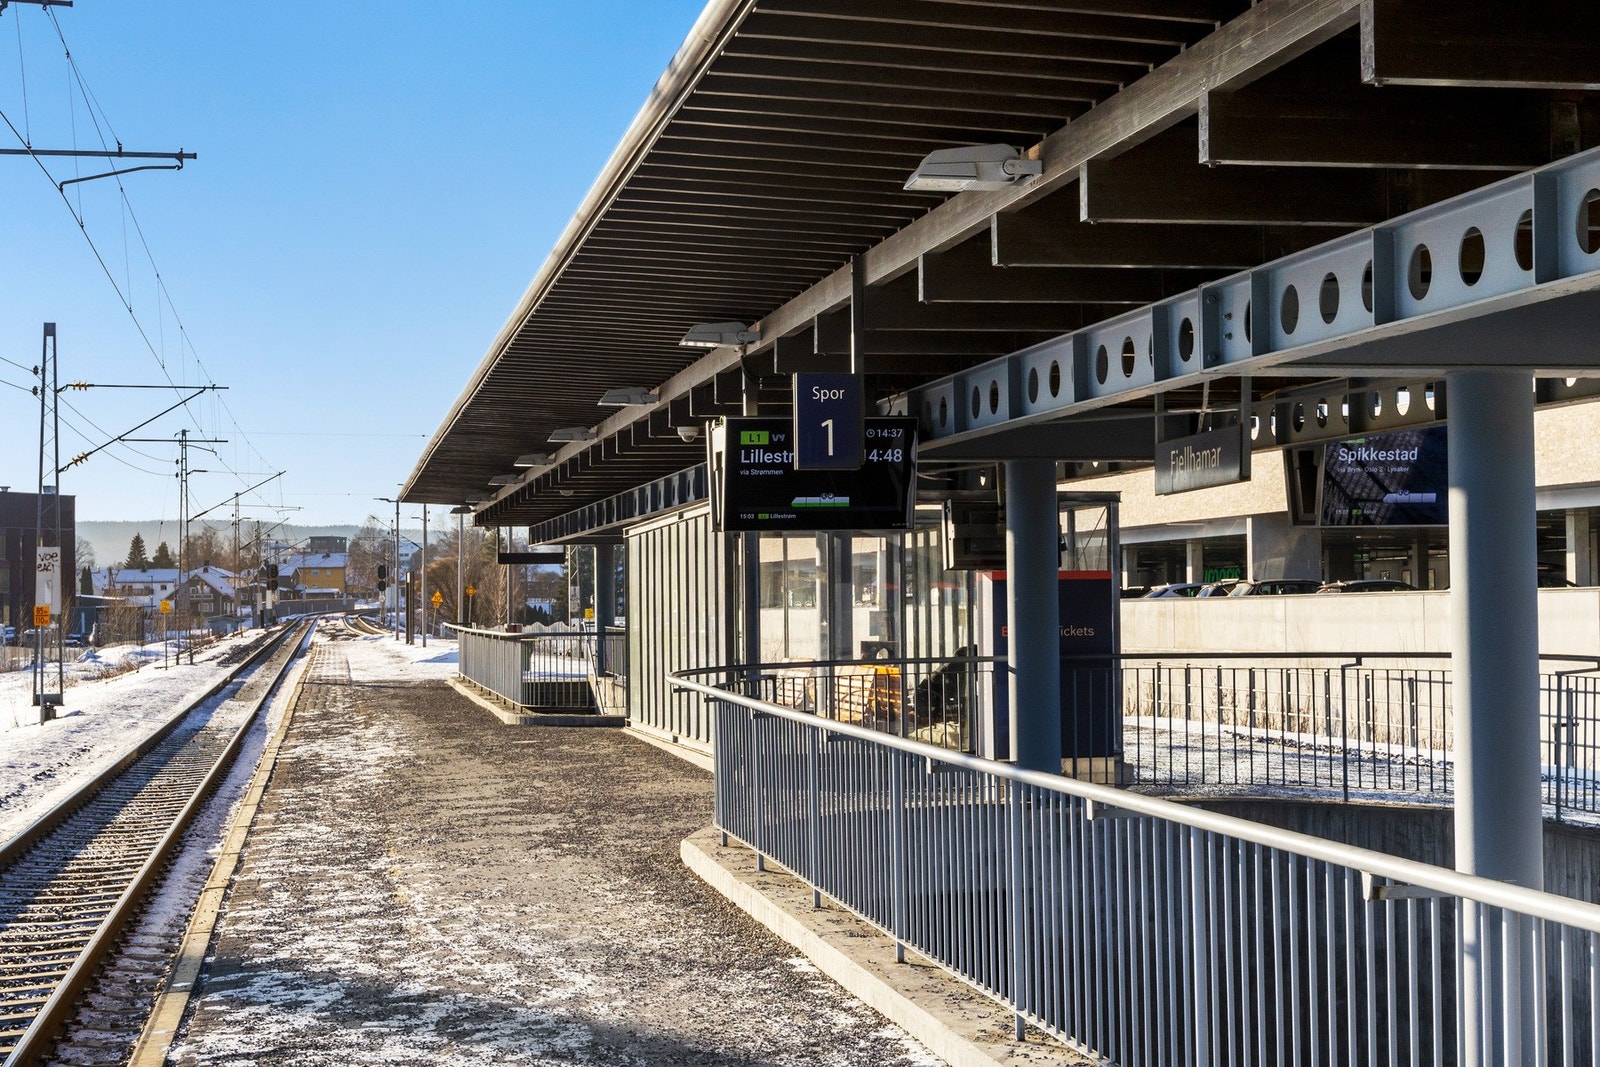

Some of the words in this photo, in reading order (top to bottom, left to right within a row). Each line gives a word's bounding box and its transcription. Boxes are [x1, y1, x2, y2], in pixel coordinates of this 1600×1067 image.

[812, 386, 845, 403] Spor
[749, 433, 761, 443] L1
[821, 418, 834, 456] 1
[876, 428, 903, 438] 14:37
[741, 449, 795, 463] Lillestr
[1170, 445, 1222, 477] Fjellhamar
[1338, 447, 1419, 464] Spikkestad
[750, 468, 784, 476] Strømmen
